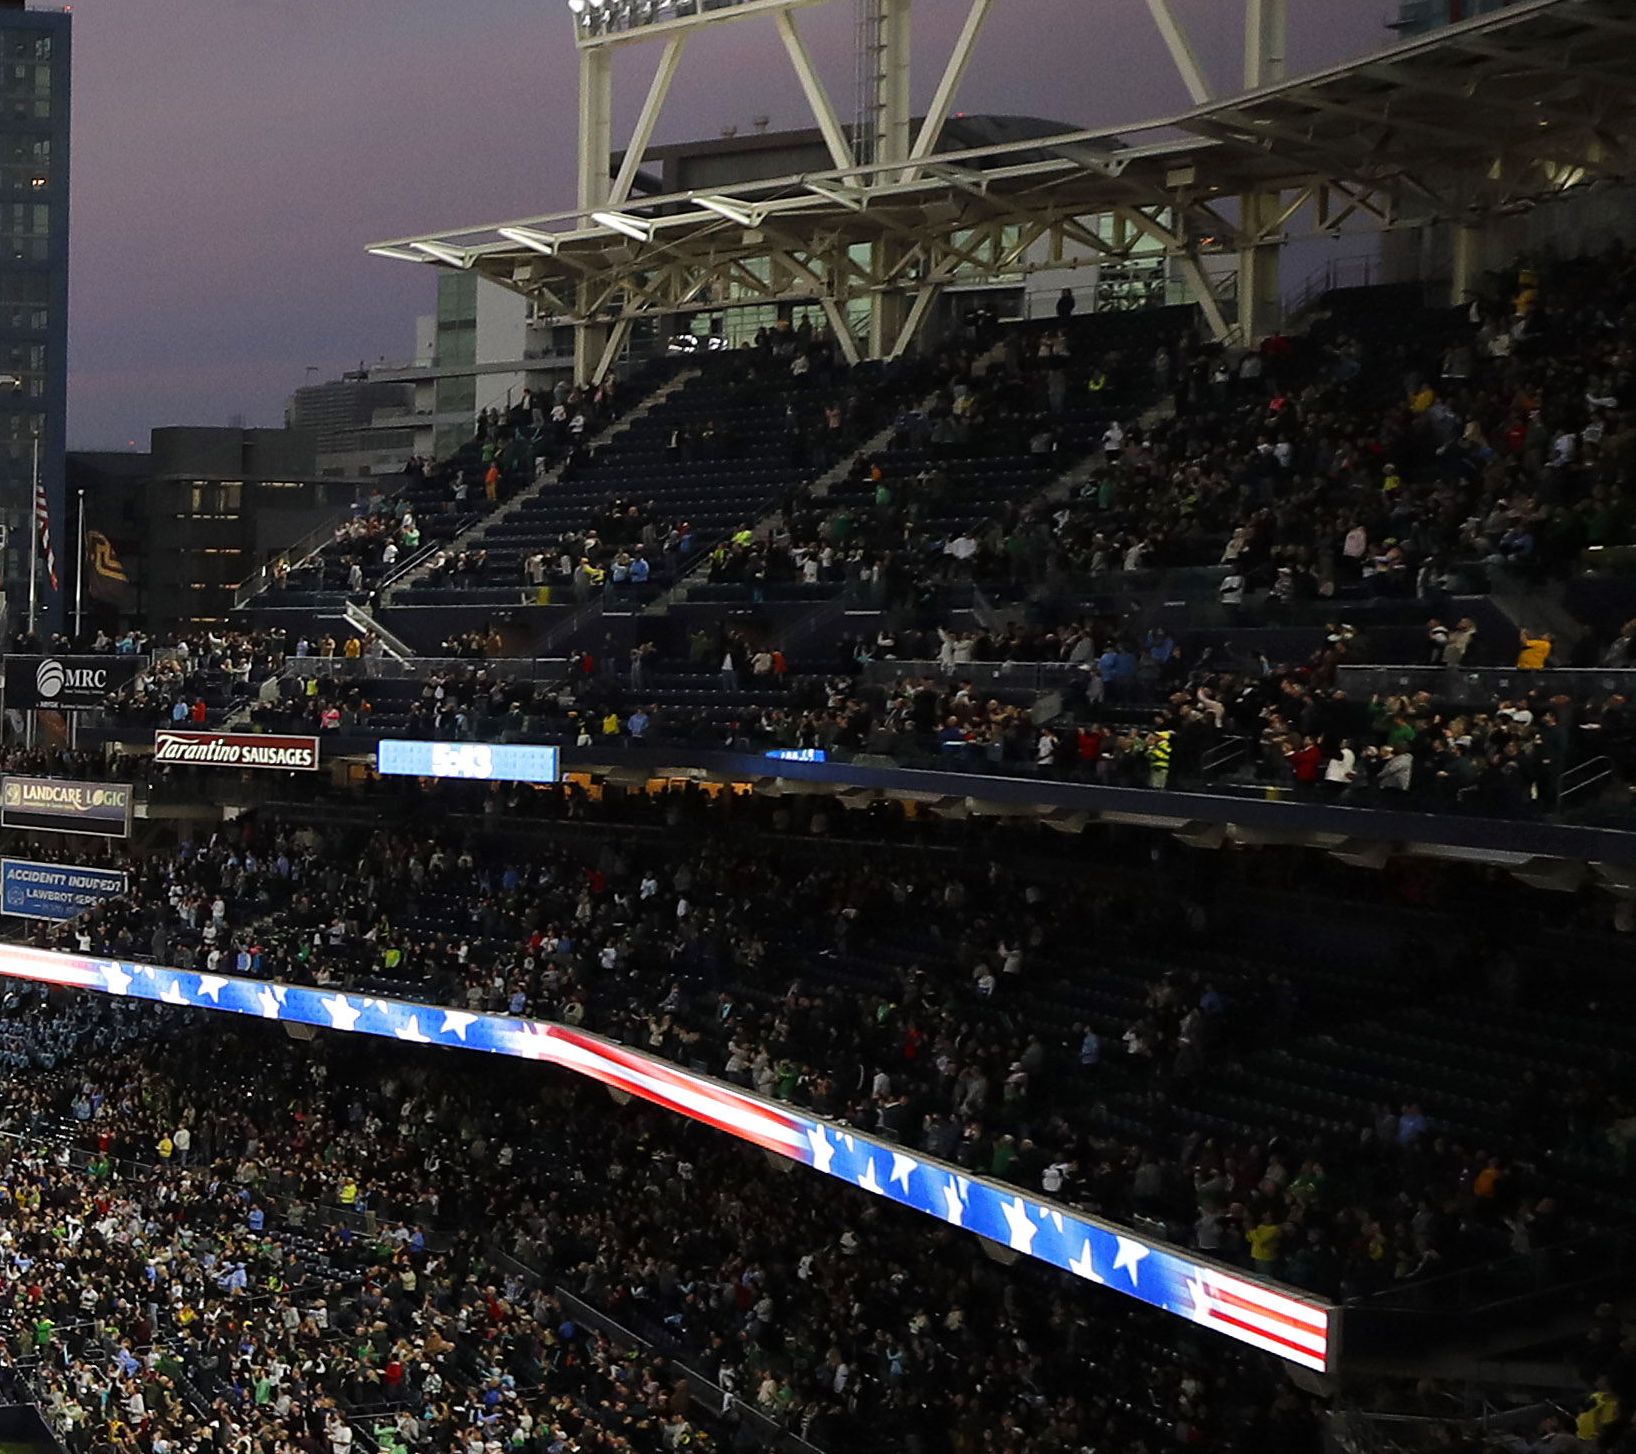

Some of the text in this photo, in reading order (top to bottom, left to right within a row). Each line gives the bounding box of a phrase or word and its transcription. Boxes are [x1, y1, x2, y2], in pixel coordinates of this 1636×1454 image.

[64, 669, 107, 688] MRC
[154, 734, 312, 766] Tarantino SAUSAGES
[432, 743, 493, 779] 5:43
[22, 784, 83, 804] LANDCARE
[86, 790, 125, 806] LOGIC
[6, 868, 68, 886] ACCIDENT?
